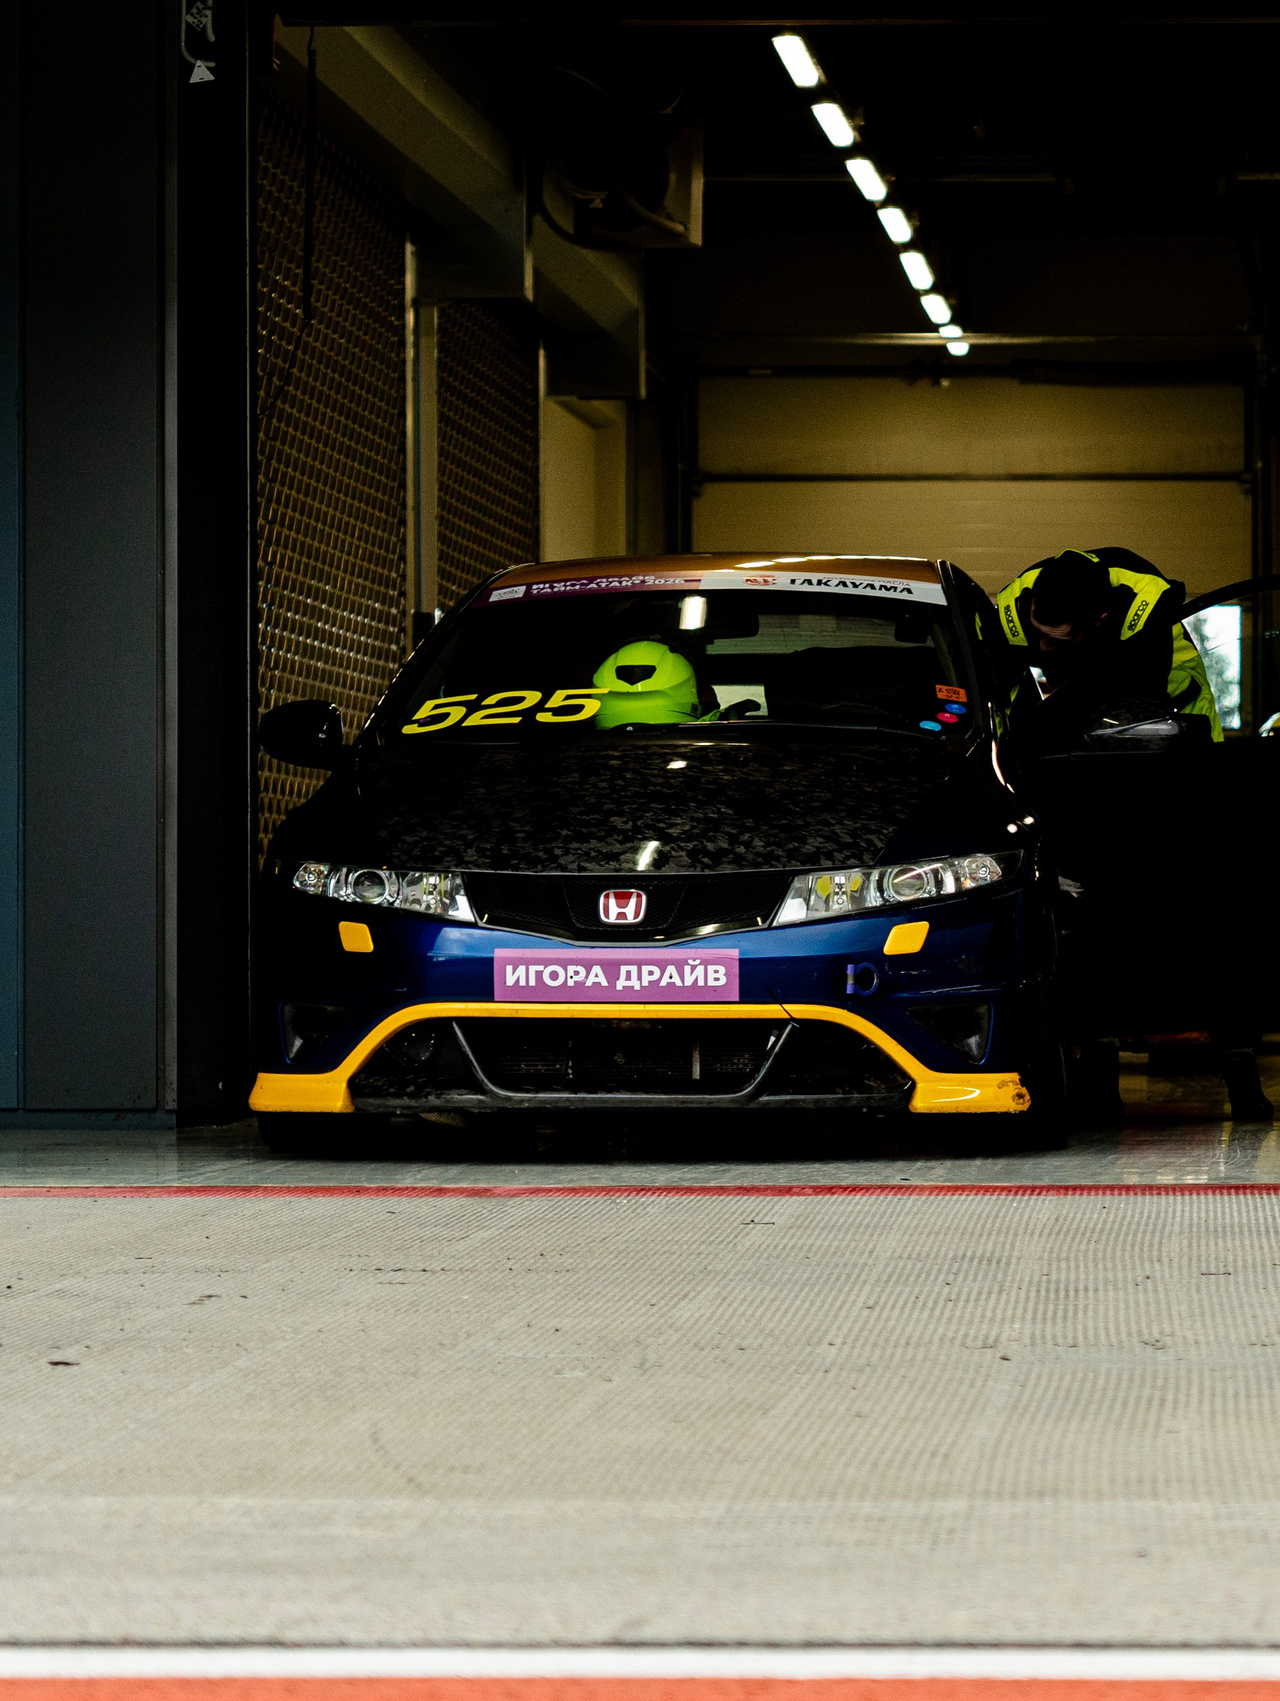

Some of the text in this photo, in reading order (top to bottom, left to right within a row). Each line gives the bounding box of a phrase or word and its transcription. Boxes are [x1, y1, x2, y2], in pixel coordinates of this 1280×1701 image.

[401, 688, 610, 734] 525
[505, 959, 727, 990] ИГОРА ДРАЙВ
